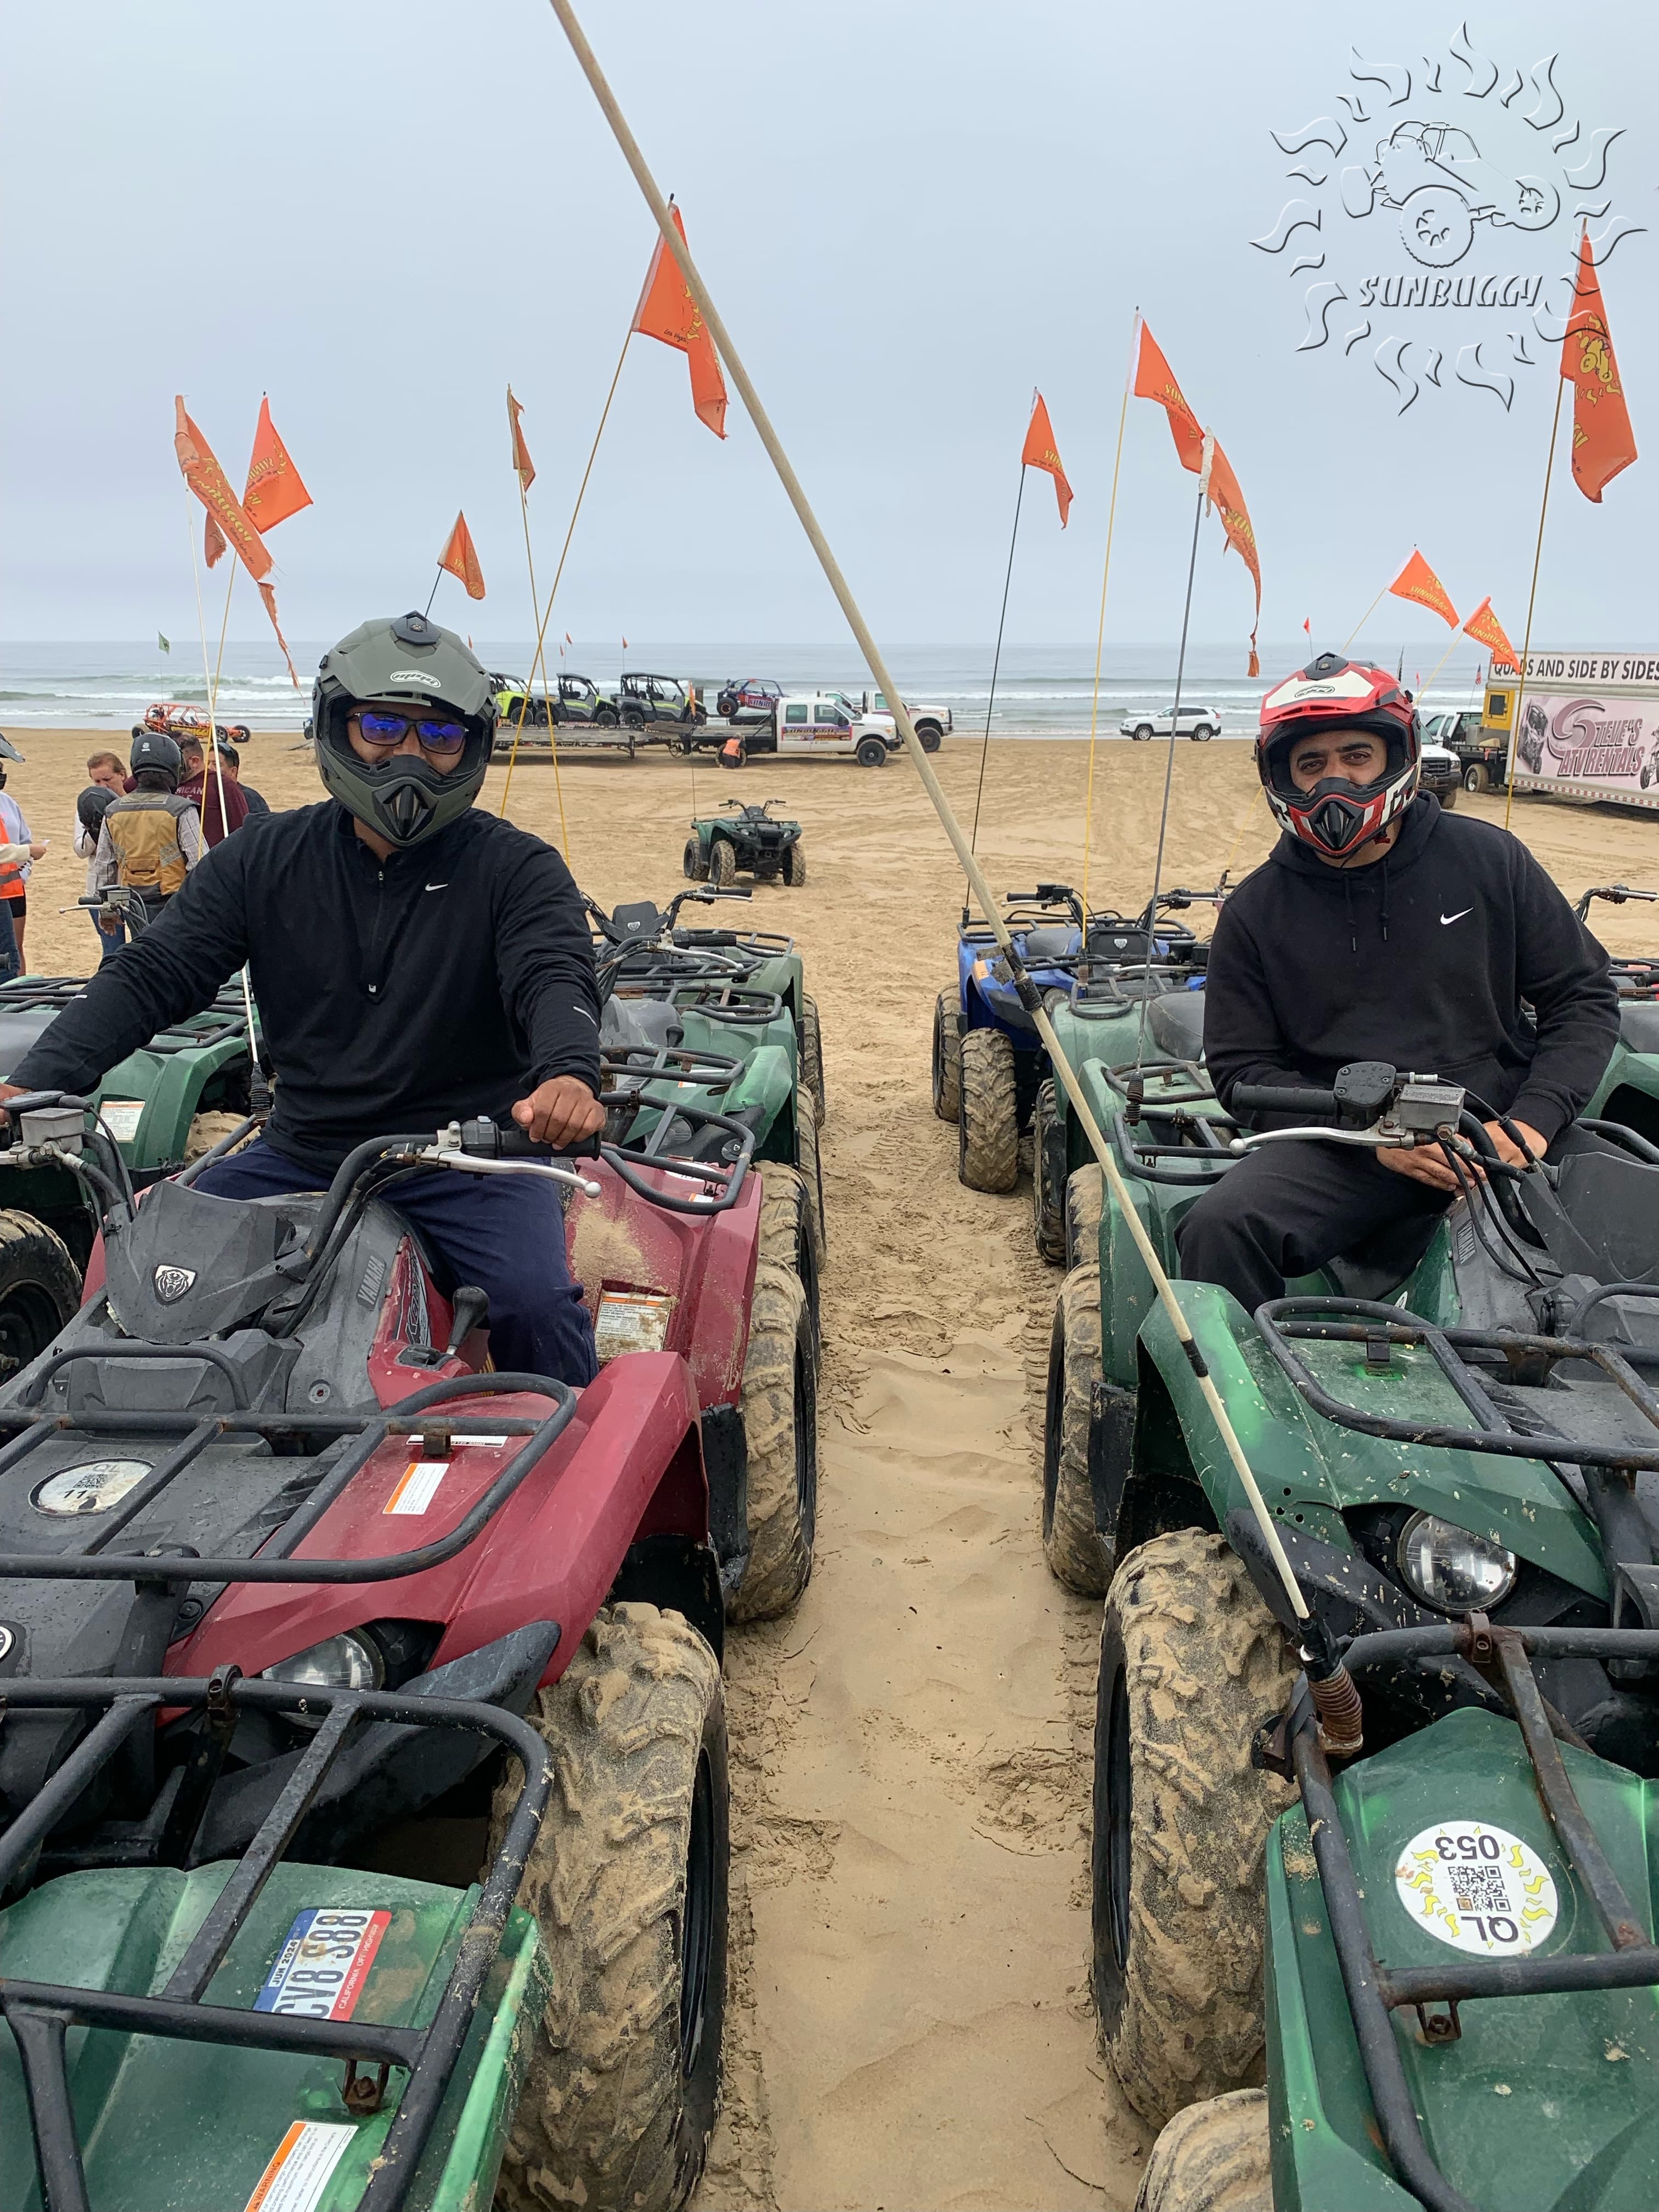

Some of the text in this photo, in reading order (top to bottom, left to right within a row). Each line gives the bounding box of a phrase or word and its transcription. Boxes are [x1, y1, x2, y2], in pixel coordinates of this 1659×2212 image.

[1536, 659, 1565, 677] AND
[1567, 659, 1598, 678] SIDE
[1600, 660, 1620, 679] BY
[1622, 660, 1659, 680] SIDES
[1558, 746, 1645, 776] ATV RENTALS
[1457, 1220, 1476, 1264] YAMAHA
[357, 1255, 385, 1305] YAMAHA
[1435, 1835, 1500, 1861] 053
[1460, 1915, 1519, 1943] QL
[272, 1942, 298, 1985] JUN 2024
[338, 1969, 360, 2010] CALIFORNIA
[363, 1924, 379, 1951] HIGHWAY
[256, 2162, 280, 2200] WARNING
